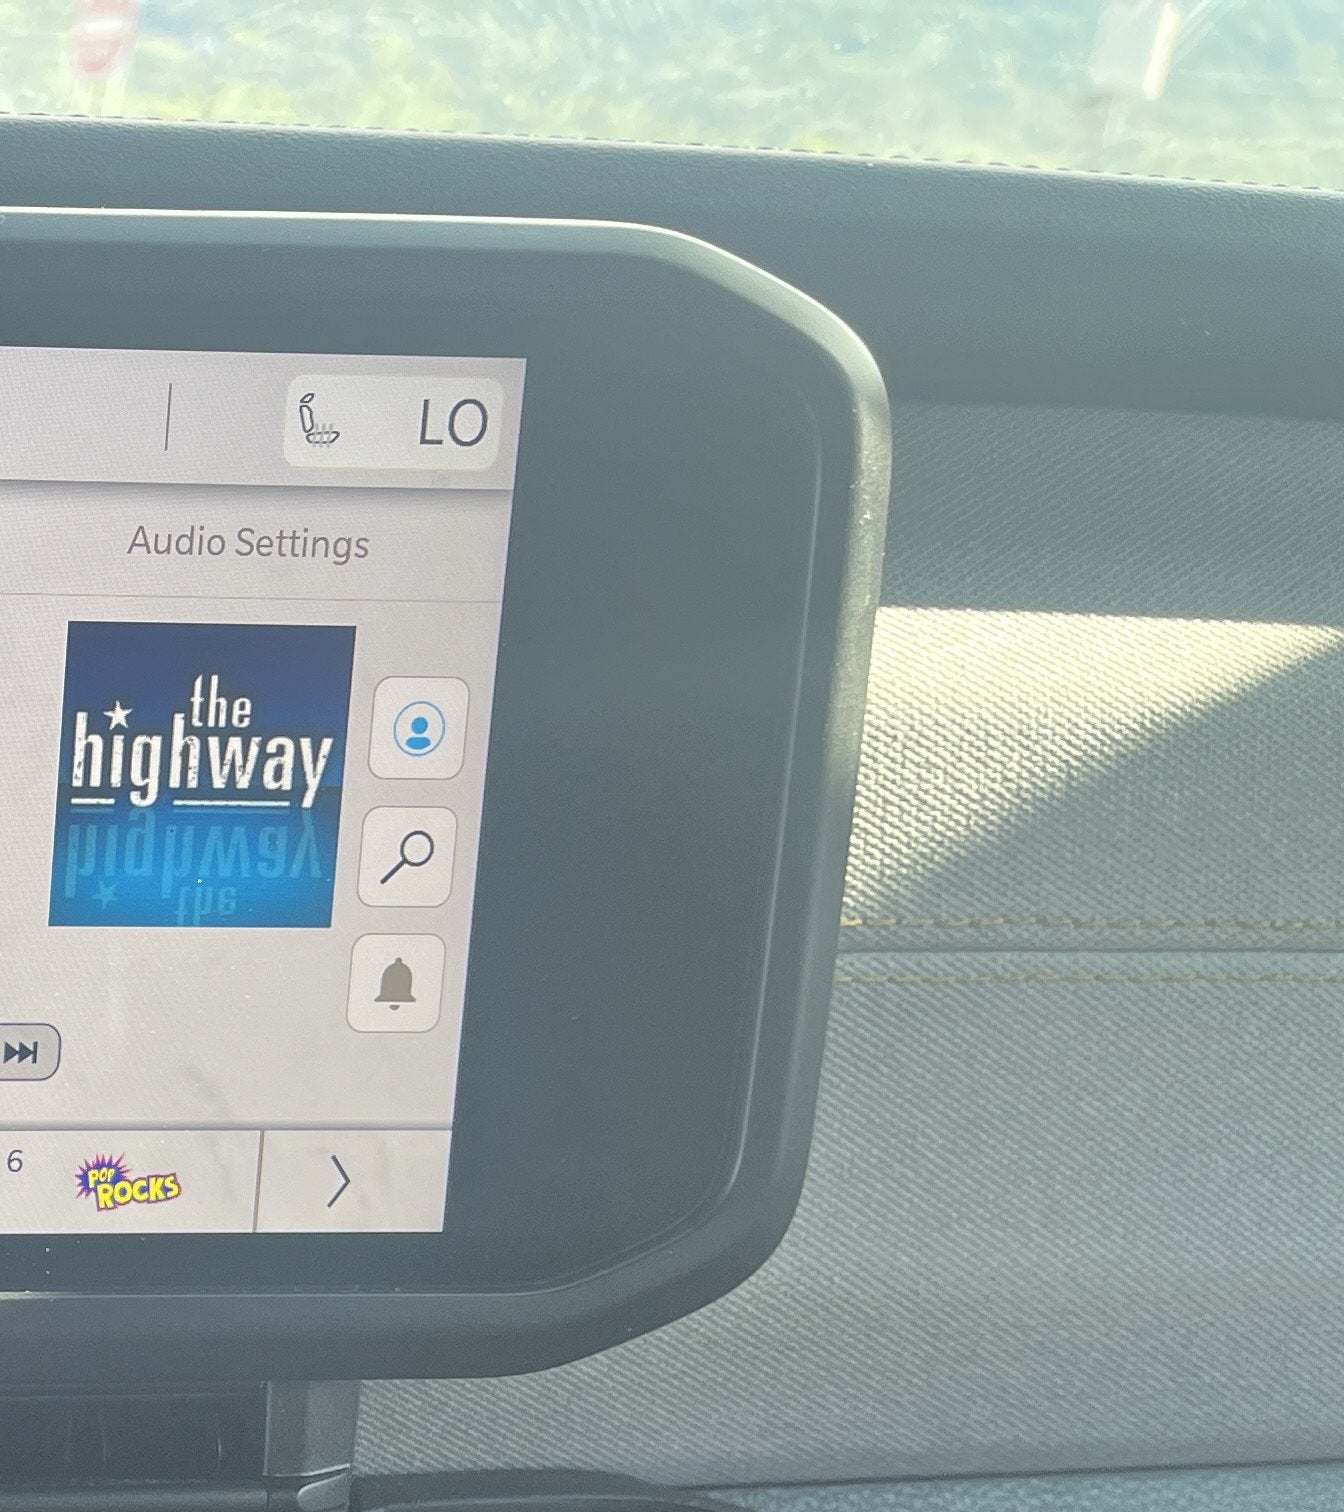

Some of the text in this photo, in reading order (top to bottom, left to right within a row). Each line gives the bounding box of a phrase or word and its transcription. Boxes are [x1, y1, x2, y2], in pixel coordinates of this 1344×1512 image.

[420, 397, 488, 447] LO
[127, 526, 370, 567] Audio Settings
[190, 674, 252, 729] the
[70, 701, 333, 809] highway
[7, 1149, 23, 1172] 6
[96, 1175, 181, 1209] ROCKS
